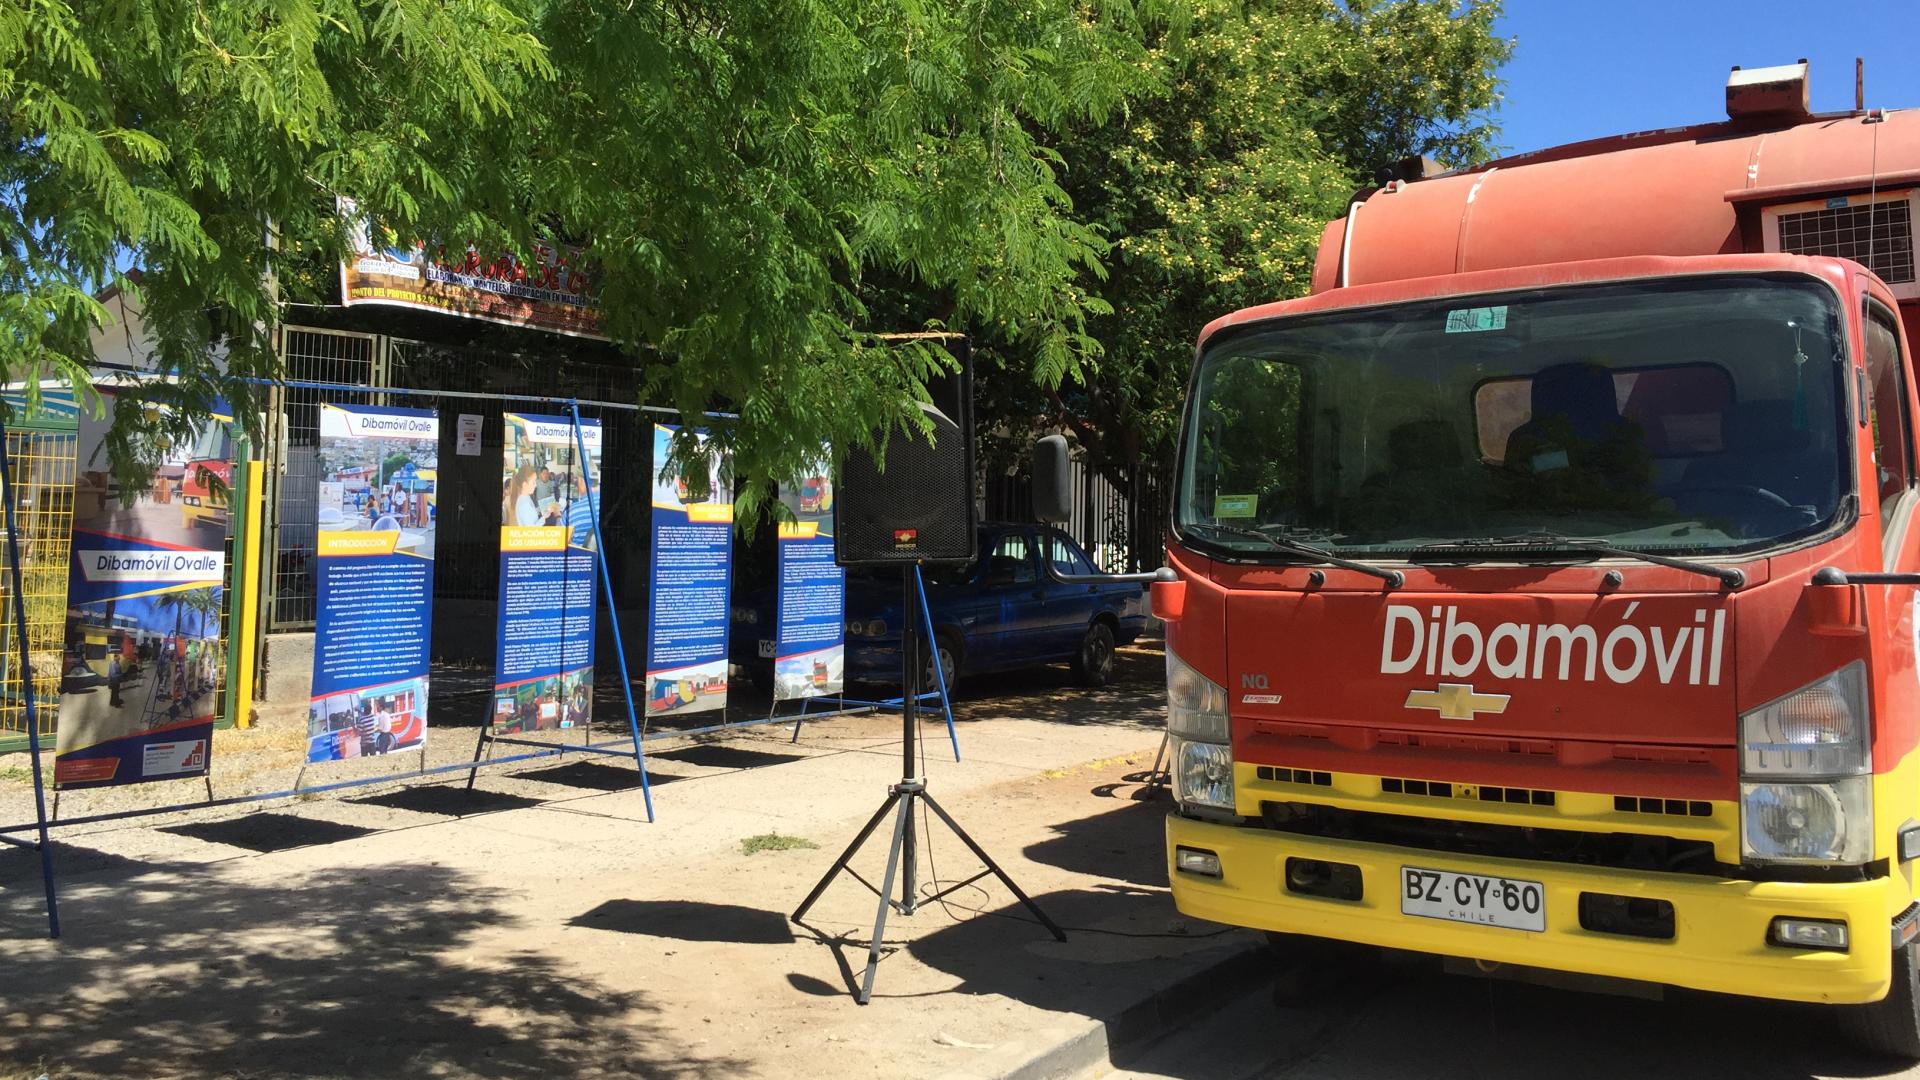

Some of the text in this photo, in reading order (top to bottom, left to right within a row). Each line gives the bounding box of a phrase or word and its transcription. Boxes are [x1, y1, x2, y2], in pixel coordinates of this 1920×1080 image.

[373, 287, 385, 297] DEL
[386, 289, 416, 302] PROYECTO
[362, 418, 432, 432] Dibamóvil Ovalle
[97, 554, 217, 571] Dibamóvil Ovalle
[1380, 601, 1726, 686] Dibamóvil
[1448, 909, 1496, 923] CHILE
